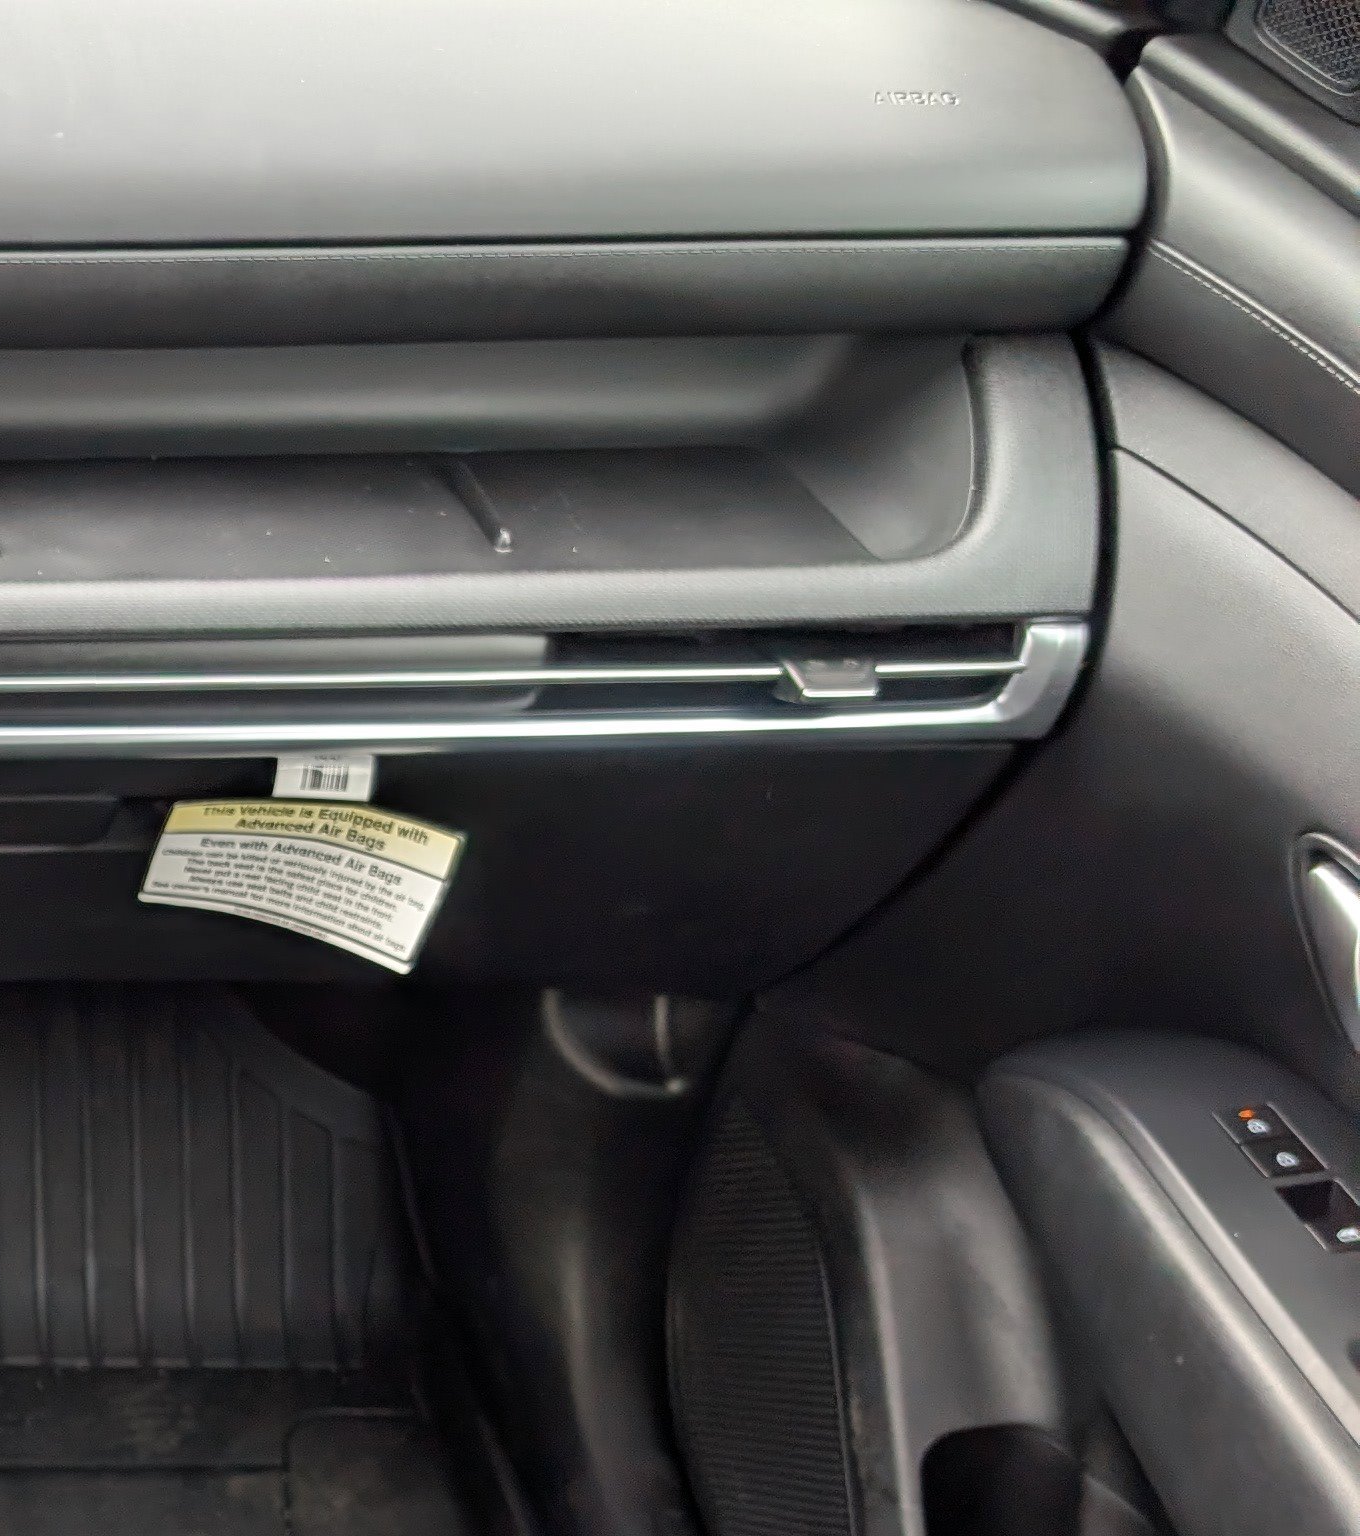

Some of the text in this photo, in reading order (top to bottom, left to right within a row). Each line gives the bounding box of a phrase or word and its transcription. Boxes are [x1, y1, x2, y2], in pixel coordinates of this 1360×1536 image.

[235, 818, 387, 851] Advanced Air Bags
[319, 808, 395, 835] Equipped
[396, 825, 429, 847] with
[271, 843, 343, 866] Advanced
[344, 857, 365, 873] Air
[368, 864, 402, 886] Bags
